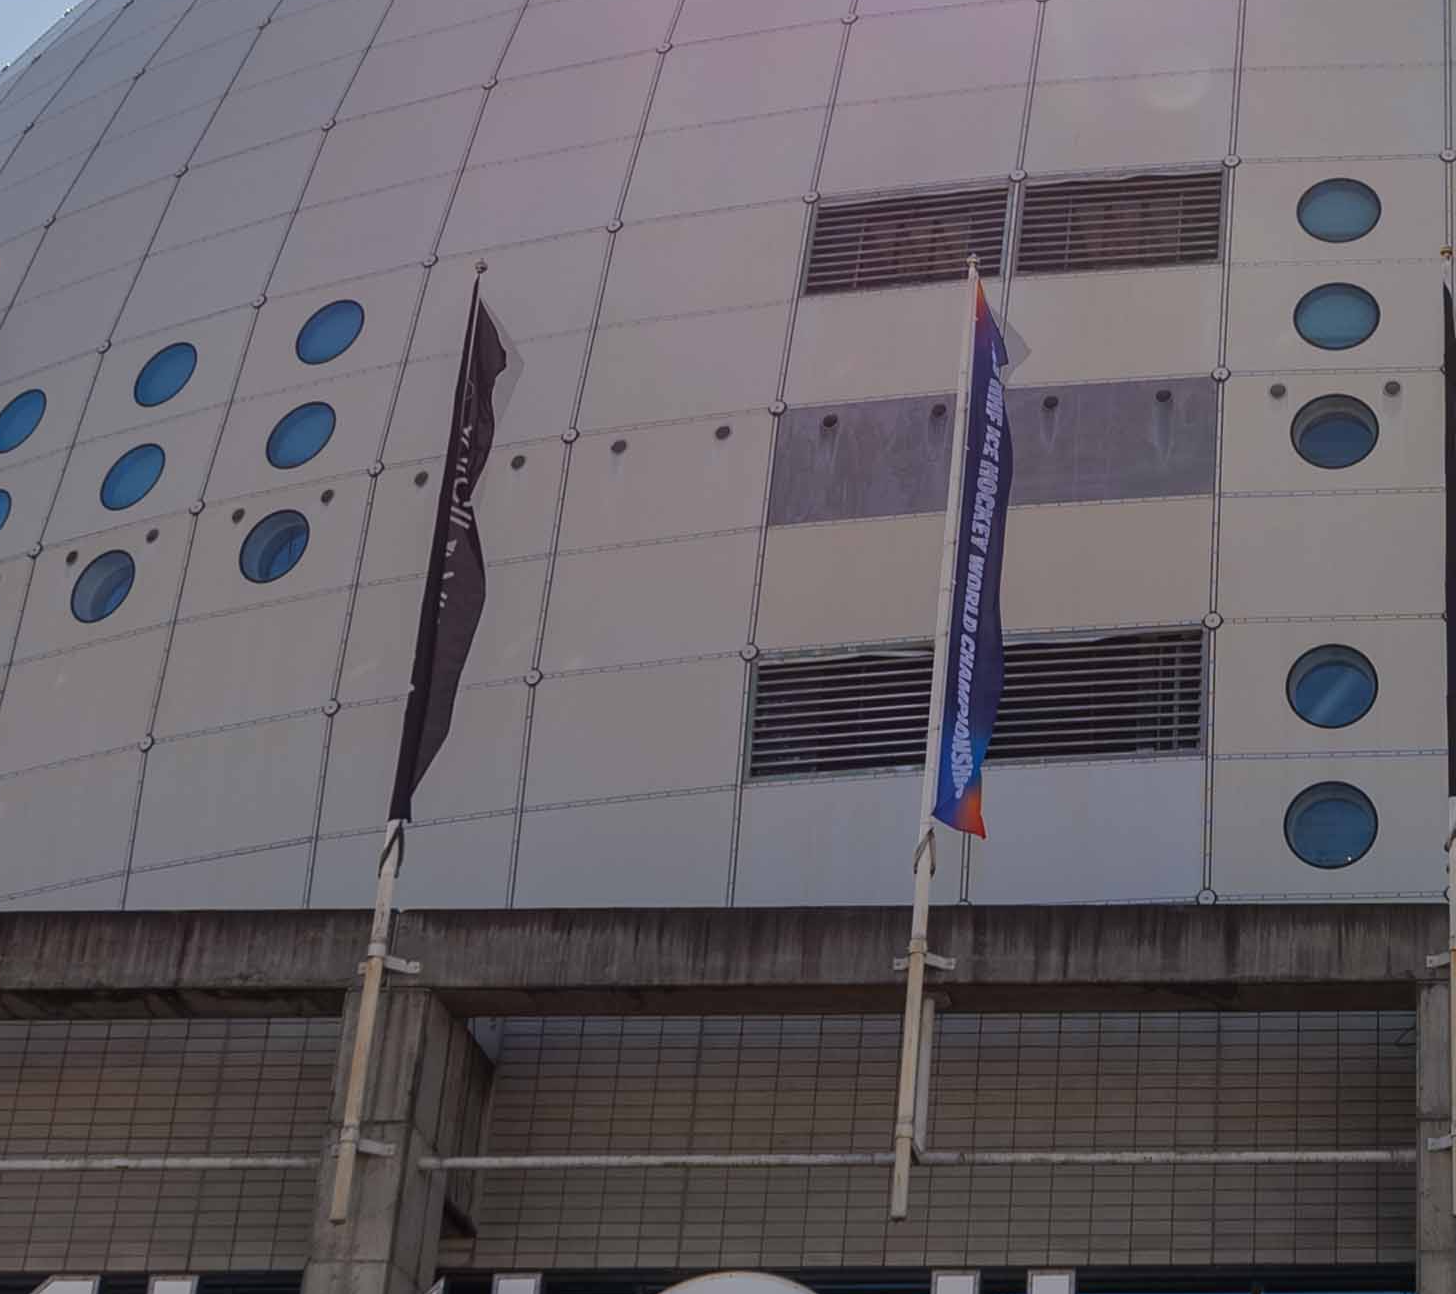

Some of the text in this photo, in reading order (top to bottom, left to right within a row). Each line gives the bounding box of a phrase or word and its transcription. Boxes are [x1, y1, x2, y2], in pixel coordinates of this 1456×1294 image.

[981, 427, 1001, 459] ICE
[968, 460, 999, 553] HOCKEY
[960, 555, 984, 634] WORLD
